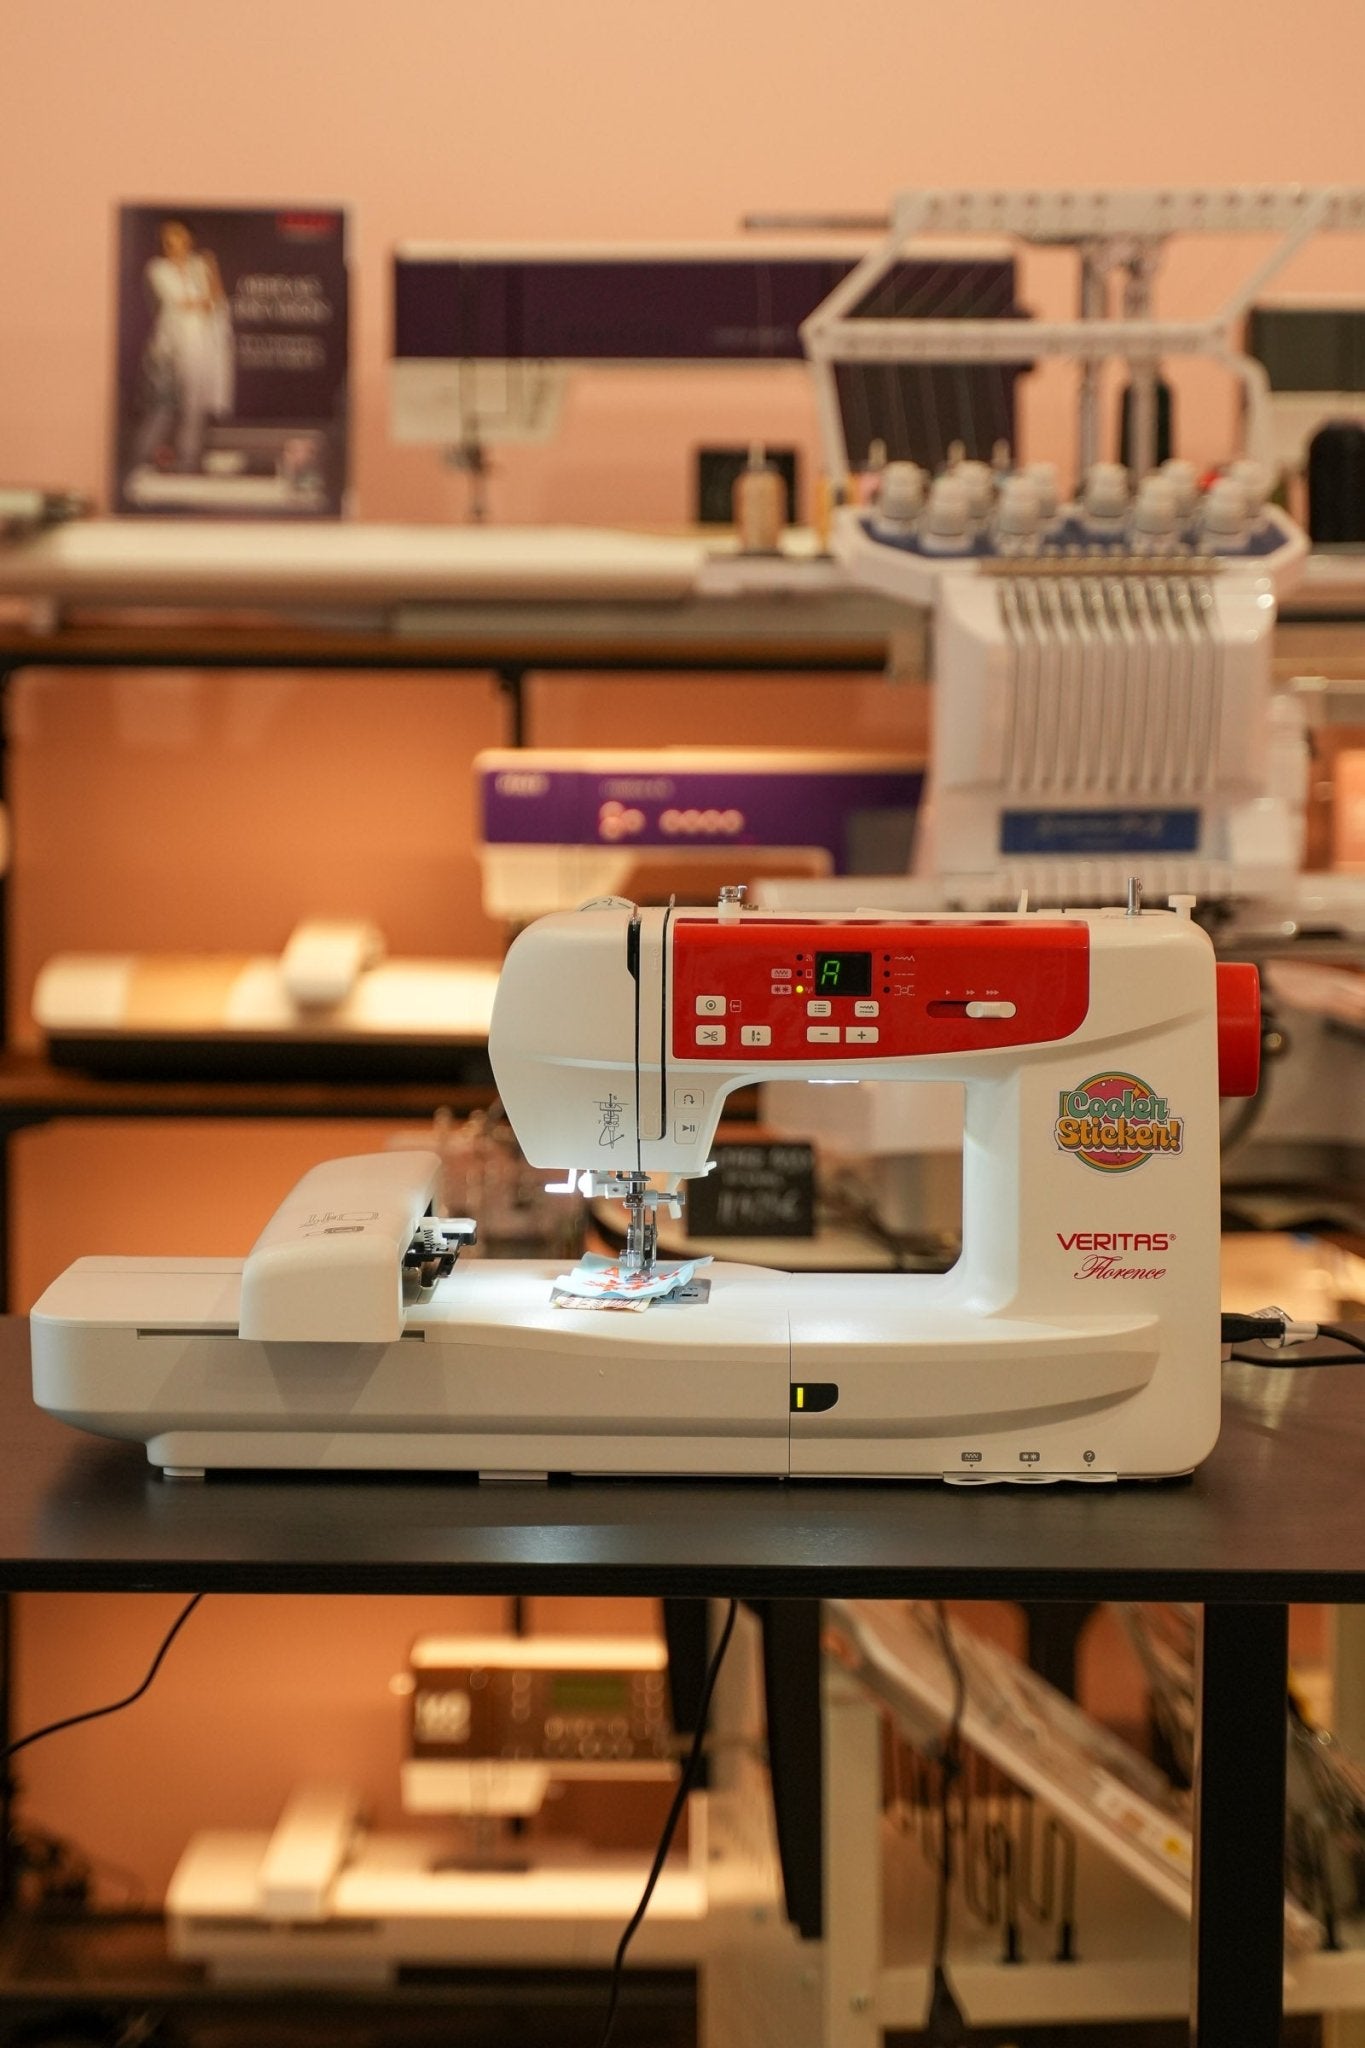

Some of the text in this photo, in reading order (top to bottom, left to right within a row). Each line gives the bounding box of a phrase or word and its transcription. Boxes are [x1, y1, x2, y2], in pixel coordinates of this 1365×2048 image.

[820, 960, 840, 985] A
[1067, 1089, 1168, 1120] Cooler
[1057, 1116, 1181, 1152] Sticker!
[1073, 1254, 1167, 1280] Florence
